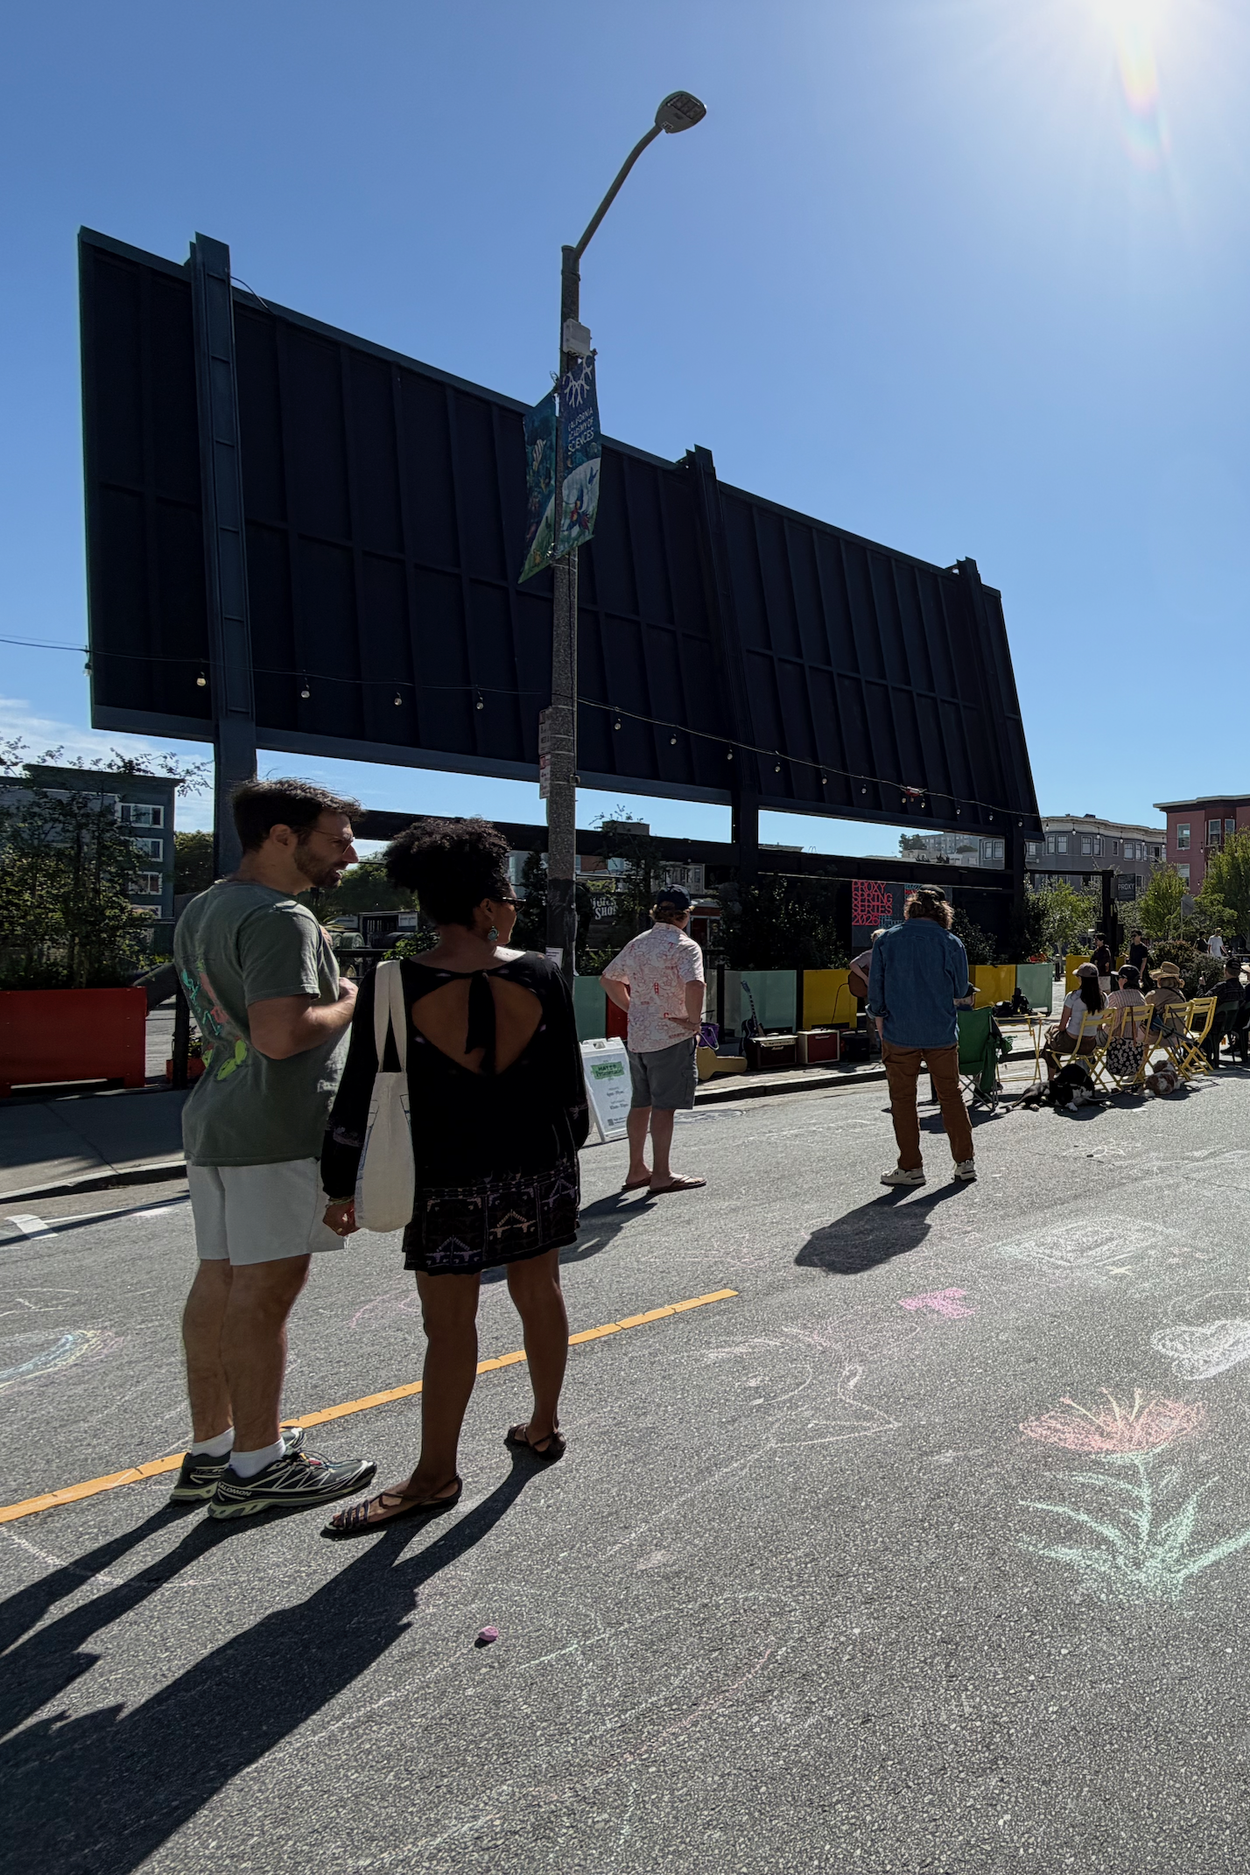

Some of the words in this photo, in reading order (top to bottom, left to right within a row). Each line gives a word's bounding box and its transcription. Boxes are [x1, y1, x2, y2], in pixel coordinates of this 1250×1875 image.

[568, 428, 594, 455] SCIENCES
[852, 880, 887, 893] PROXY
[851, 891, 893, 905] SPRING
[851, 903, 893, 916] SERIES
